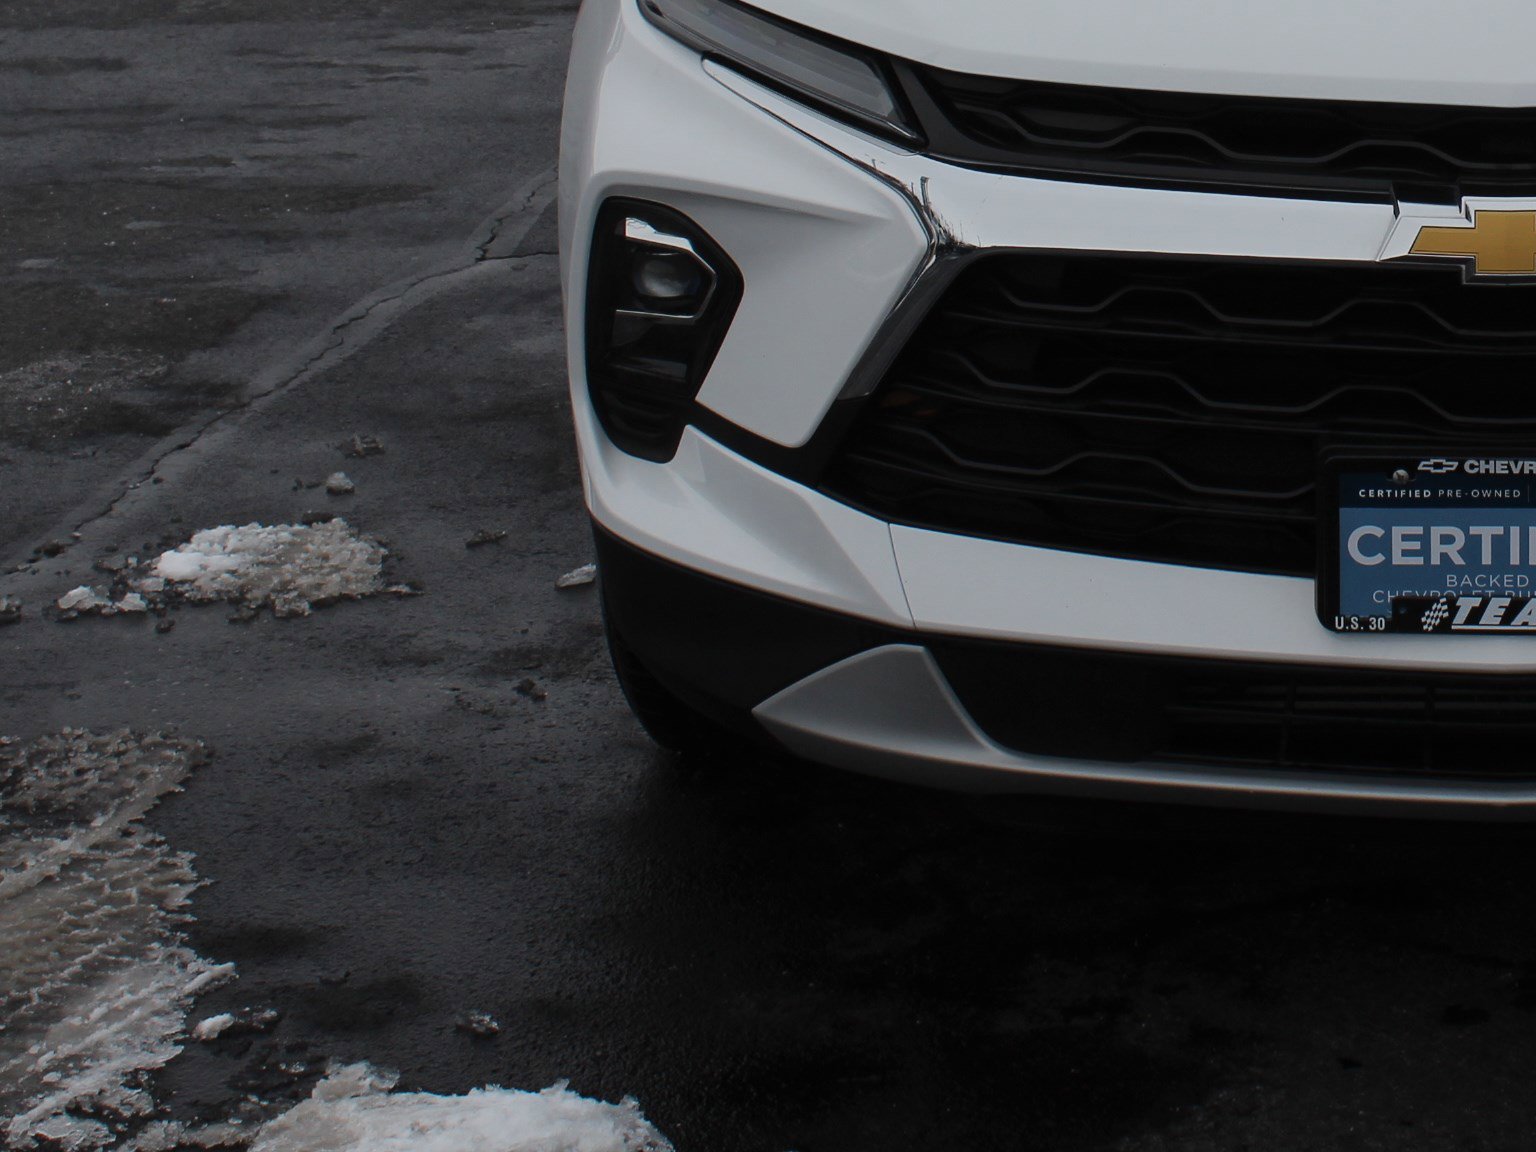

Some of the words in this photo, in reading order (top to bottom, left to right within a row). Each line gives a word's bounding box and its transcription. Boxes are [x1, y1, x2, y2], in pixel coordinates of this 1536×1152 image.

[1358, 489, 1432, 498] CERTIFIED
[1438, 489, 1521, 499] PRE-OWNED
[1446, 574, 1529, 588] BACKED
[1334, 616, 1364, 630] U.S.
[1369, 617, 1386, 631] 30
